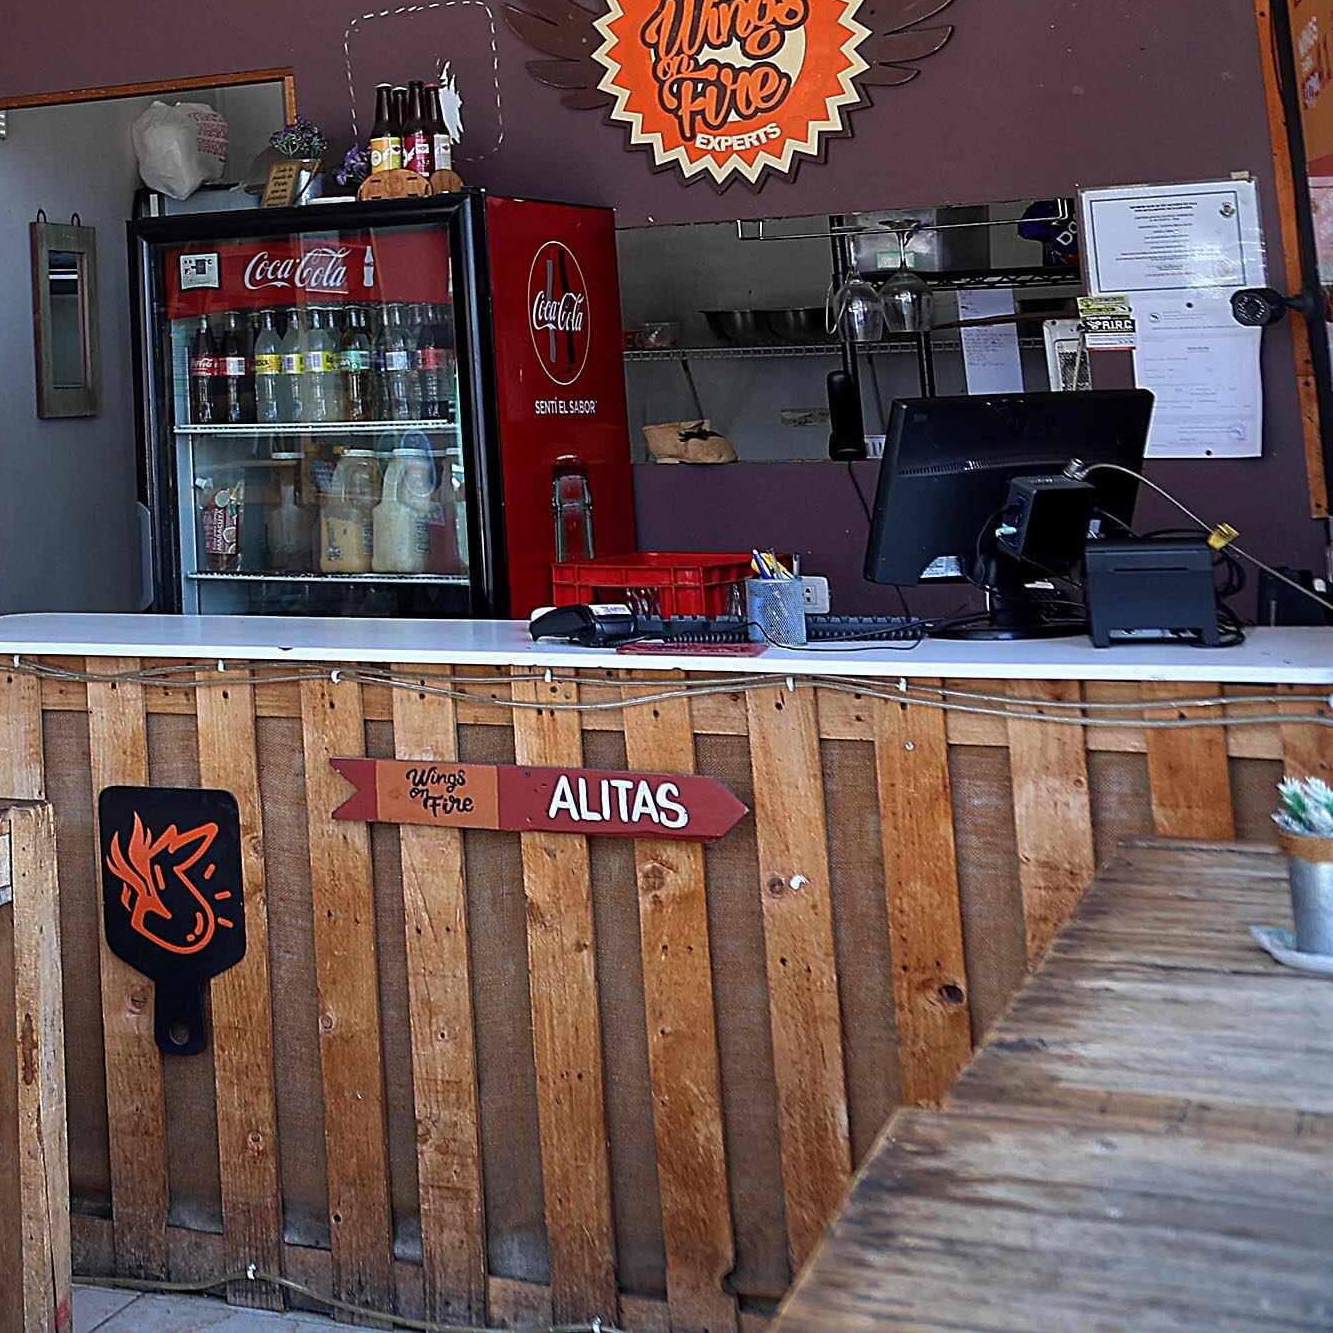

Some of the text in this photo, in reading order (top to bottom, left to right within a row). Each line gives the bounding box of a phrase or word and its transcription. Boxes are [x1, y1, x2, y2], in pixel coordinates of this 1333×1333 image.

[658, 53, 692, 80] on
[663, 64, 786, 137] Fire
[695, 123, 782, 152] EXPERTS
[559, 401, 568, 413] EL
[570, 401, 596, 413] SABOR
[406, 767, 465, 793] Wings
[410, 787, 429, 798] on
[423, 795, 473, 817] Fire
[548, 776, 689, 829] ALITAS
